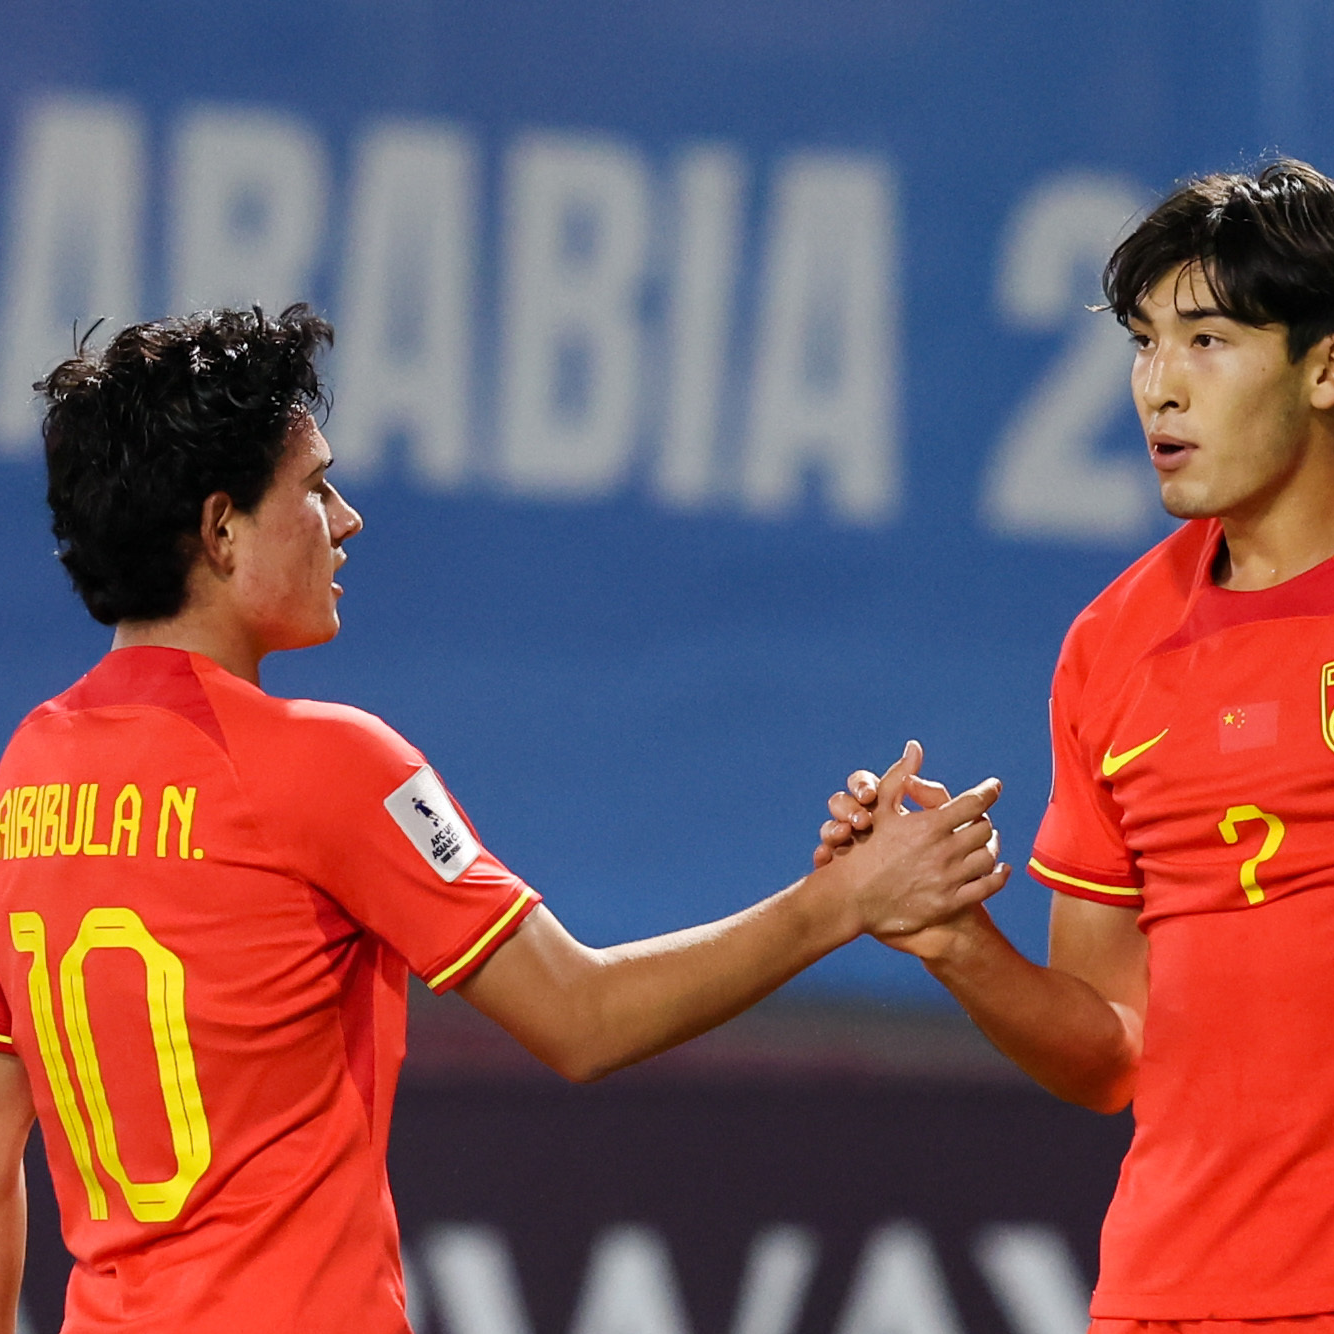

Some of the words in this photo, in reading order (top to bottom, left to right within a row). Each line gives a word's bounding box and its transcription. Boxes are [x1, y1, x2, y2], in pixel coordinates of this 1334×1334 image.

[156, 785, 204, 860] N.
[1218, 804, 1285, 905] 7
[9, 907, 213, 1223] 10
